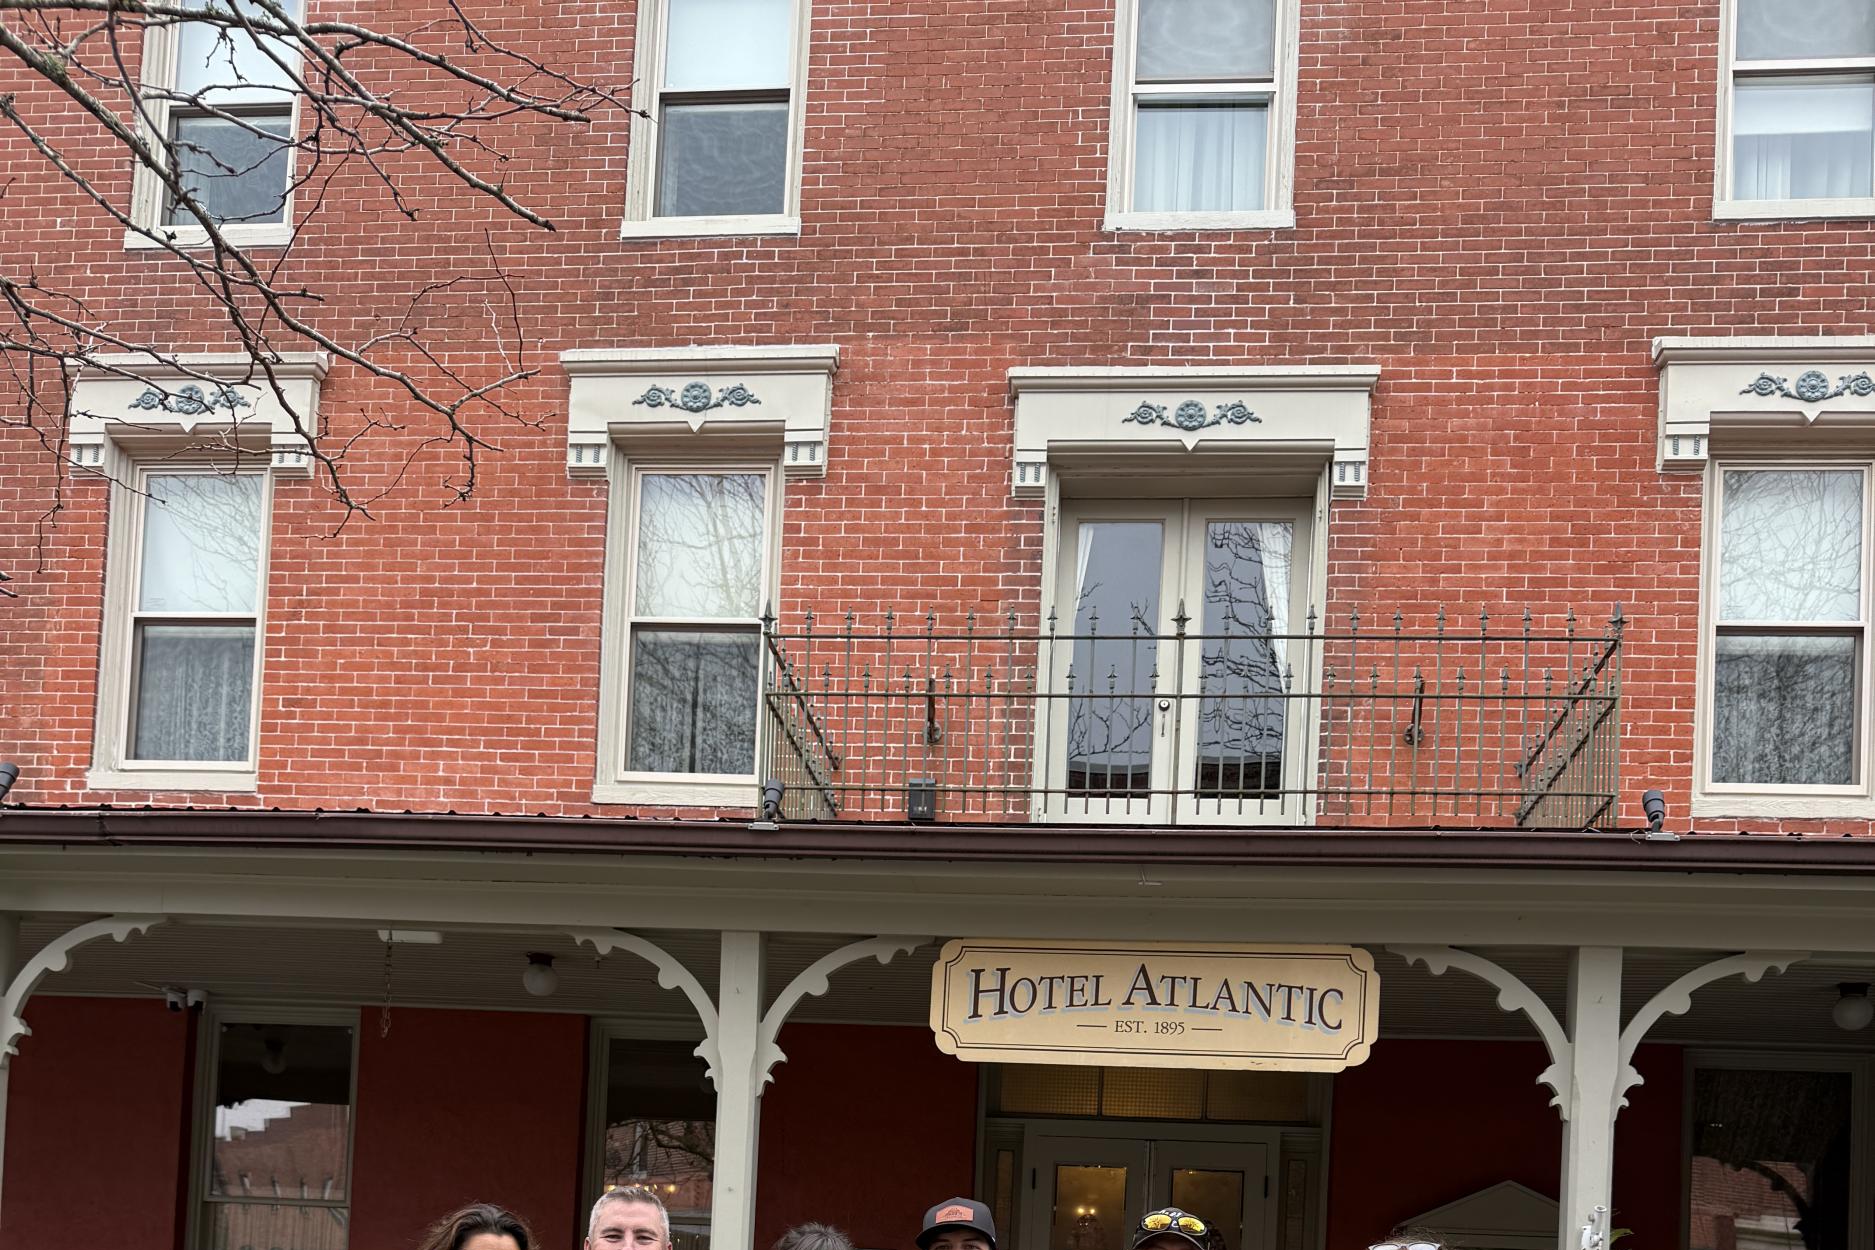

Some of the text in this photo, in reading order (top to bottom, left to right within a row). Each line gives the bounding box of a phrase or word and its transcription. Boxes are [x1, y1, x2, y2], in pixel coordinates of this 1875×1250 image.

[968, 963, 1344, 1030] HOTEL ATLANTIC
[1115, 1020, 1186, 1036] EST. 1895
